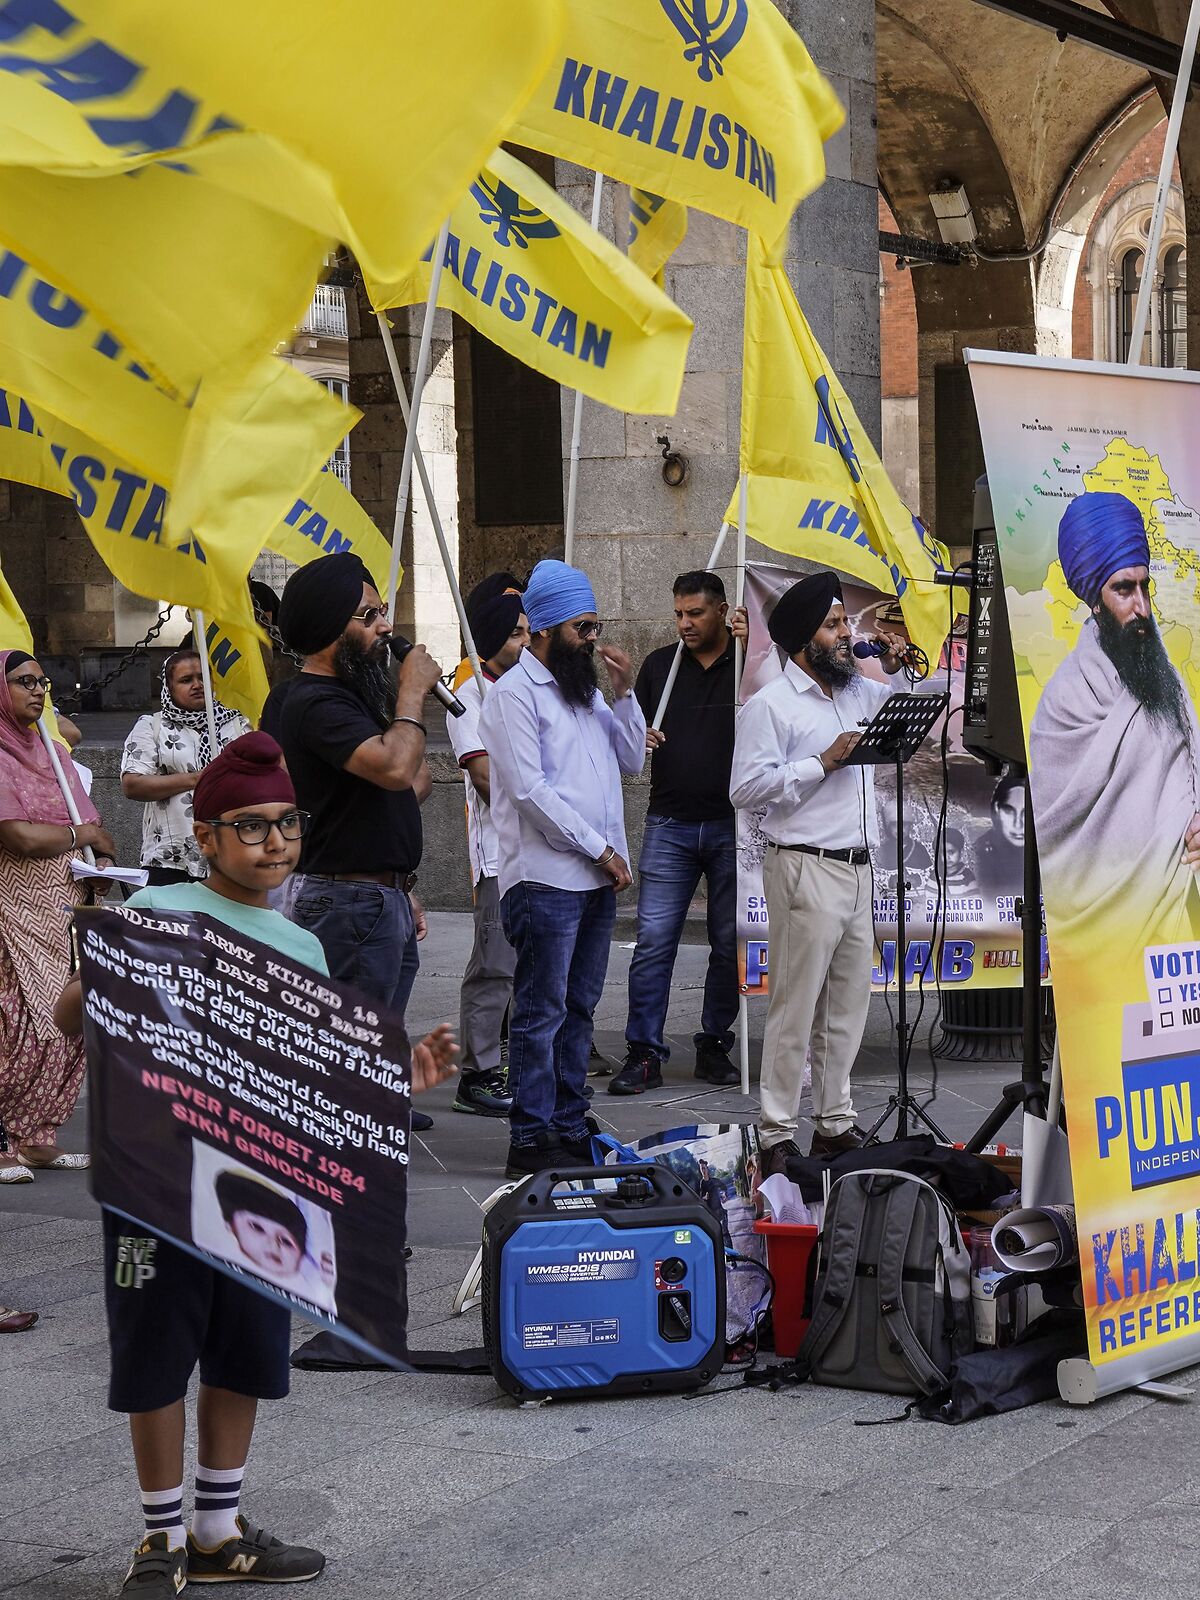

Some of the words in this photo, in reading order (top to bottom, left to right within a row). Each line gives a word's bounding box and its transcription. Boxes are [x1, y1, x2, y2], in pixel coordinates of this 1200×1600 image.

[553, 57, 777, 205] KHALISTAN
[421, 232, 613, 370] ALISTAN
[1022, 423, 1037, 432] Panja
[1038, 424, 1053, 432] Sahib
[1103, 428, 1128, 436] KASHMIR
[1040, 490, 1062, 498] Nankana
[1126, 467, 1150, 476] Himachal
[1128, 473, 1149, 482] Pradesh
[1163, 509, 1193, 519] Uttarakhand
[965, 911, 984, 923] KAUR
[86, 928, 173, 976] Shaheed
[178, 965, 222, 993] Bhai
[227, 983, 315, 1037] Manpreet
[317, 1028, 371, 1062] Singh
[202, 928, 256, 965] ARMY
[265, 960, 343, 1010] KILLED
[353, 1005, 380, 1027] 18
[215, 957, 270, 993] DAYS
[280, 990, 321, 1018] OLD
[329, 1013, 384, 1047] BABY
[1182, 1007, 1200, 1026] NO
[83, 942, 127, 978] were
[130, 971, 180, 995] only
[184, 980, 206, 1001] 18
[209, 993, 256, 1025] days
[259, 1017, 290, 1041] old
[293, 1031, 342, 1065] when
[344, 1057, 356, 1072] a
[359, 1059, 411, 1098] bullet
[167, 994, 206, 1017] was
[209, 1009, 252, 1041] fired
[256, 1034, 276, 1052] at
[278, 1042, 331, 1077] them.
[85, 1001, 134, 1043] days,
[136, 1029, 192, 1056] what
[194, 1046, 246, 1082] could
[247, 1072, 290, 1109] they
[292, 1098, 364, 1149] possibly
[367, 1133, 409, 1165] have
[87, 987, 137, 1026] After
[140, 1014, 203, 1047] being
[206, 1033, 224, 1056] in
[226, 1046, 257, 1074] the
[258, 1066, 310, 1102] world
[313, 1090, 341, 1115] for
[343, 1109, 383, 1140] only
[386, 1125, 406, 1146] 18
[151, 1046, 203, 1078] done
[205, 1066, 226, 1090] to
[228, 1080, 299, 1128] deserve
[301, 1117, 345, 1151] this?
[141, 1068, 224, 1118] NEVER
[228, 1105, 315, 1164] FORGET
[317, 1155, 367, 1194] 1984
[171, 1102, 229, 1142] SIKH
[234, 1134, 345, 1206] GENOCIDE
[115, 1264, 157, 1289] UP
[578, 1249, 636, 1263] HYUNDAI
[525, 1325, 554, 1333] HYUNDAI
